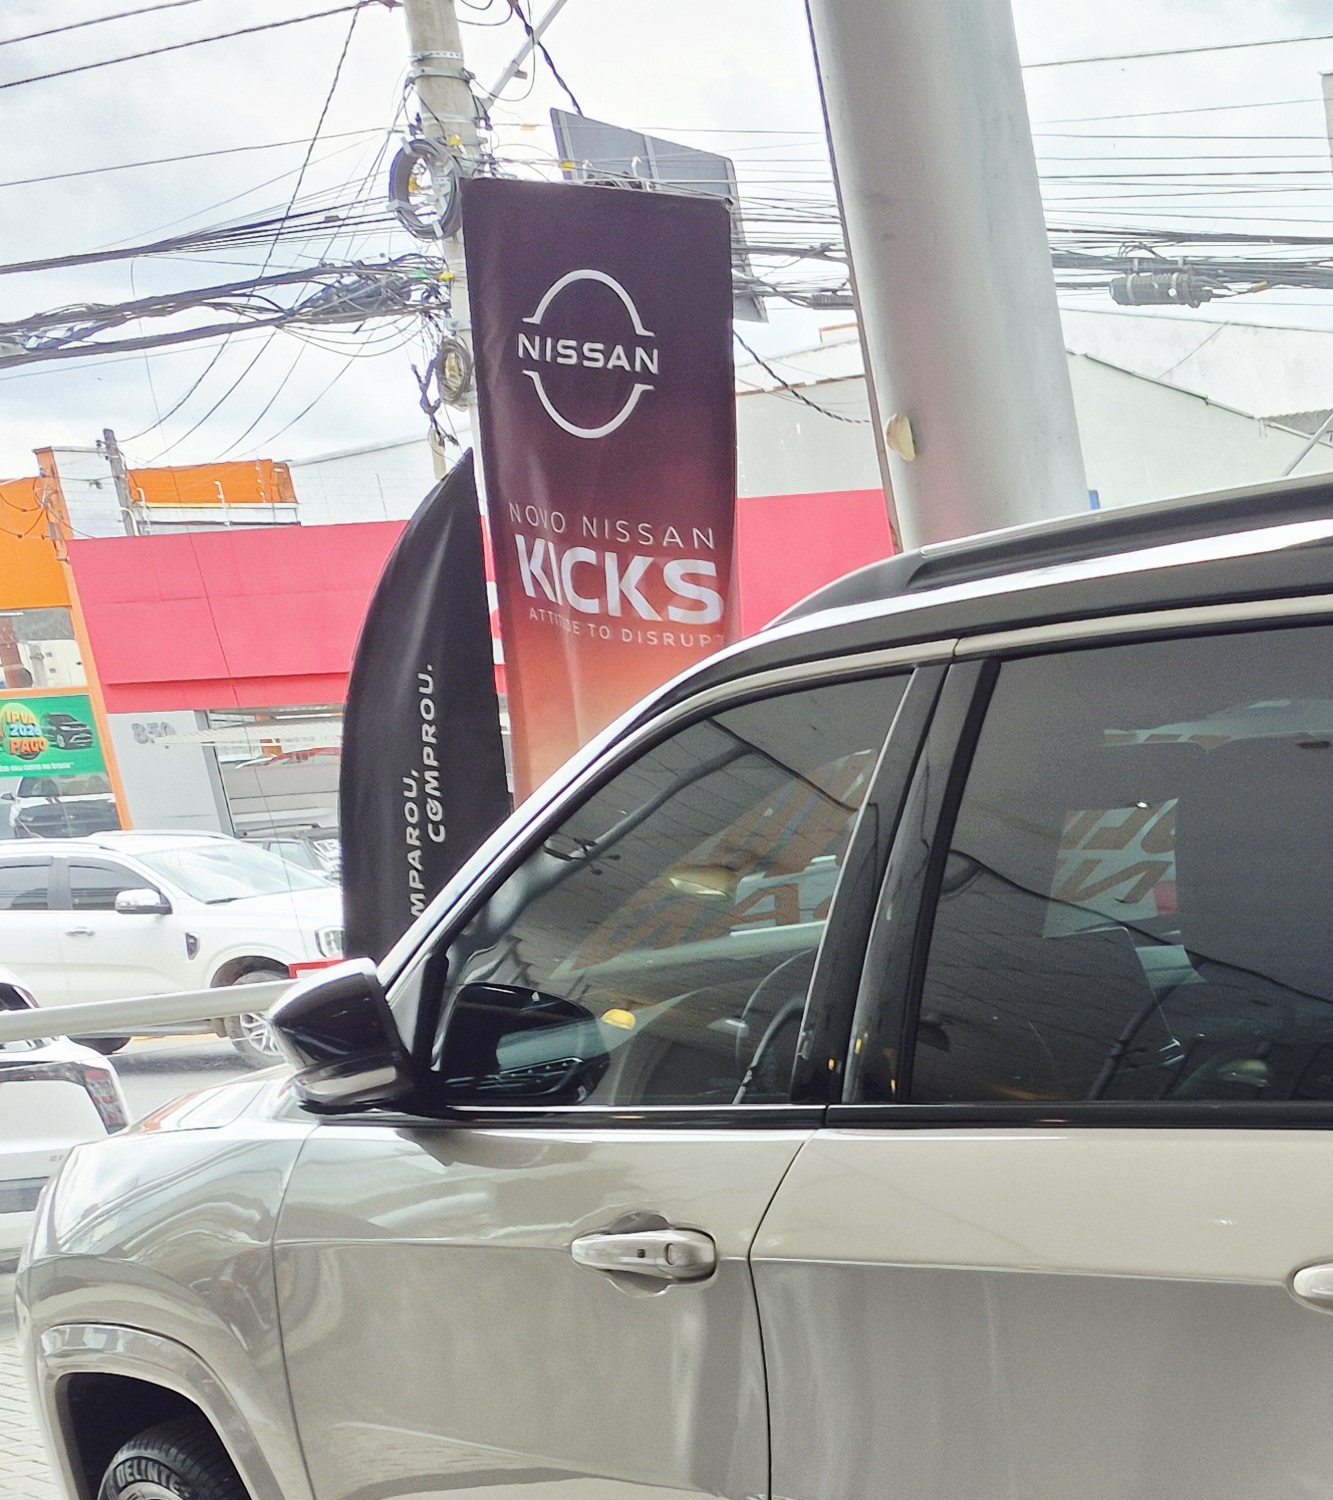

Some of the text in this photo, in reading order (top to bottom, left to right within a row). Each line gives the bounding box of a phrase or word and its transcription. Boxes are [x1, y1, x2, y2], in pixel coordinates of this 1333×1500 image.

[517, 332, 660, 375] NISSAN
[508, 502, 716, 550] NOVO NISSAN
[514, 533, 725, 626] KICKS
[587, 622, 611, 640] TO
[417, 663, 446, 843] COMPROU.
